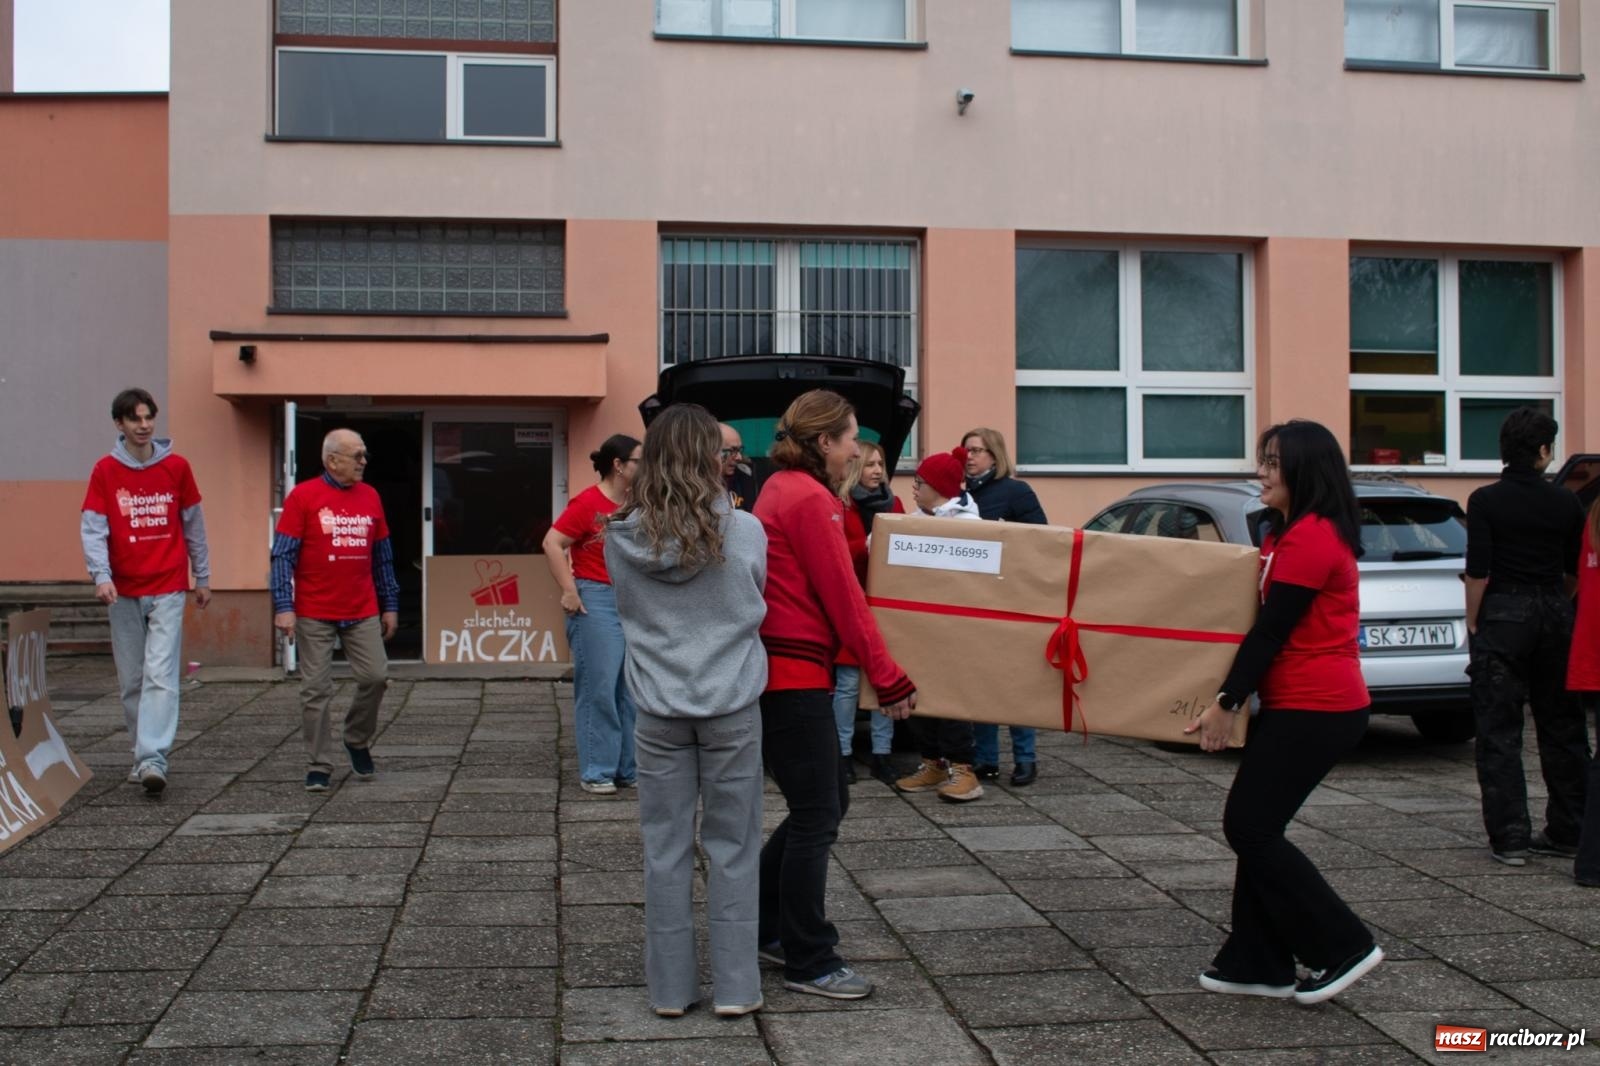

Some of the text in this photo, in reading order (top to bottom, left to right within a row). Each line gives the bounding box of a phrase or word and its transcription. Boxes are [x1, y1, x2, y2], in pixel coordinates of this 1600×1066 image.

[894, 540, 989, 559] SLA-1297-166995
[463, 609, 532, 628] szlachetna
[1369, 626, 1448, 645] SK 371WY
[439, 629, 557, 662] PACZKA
